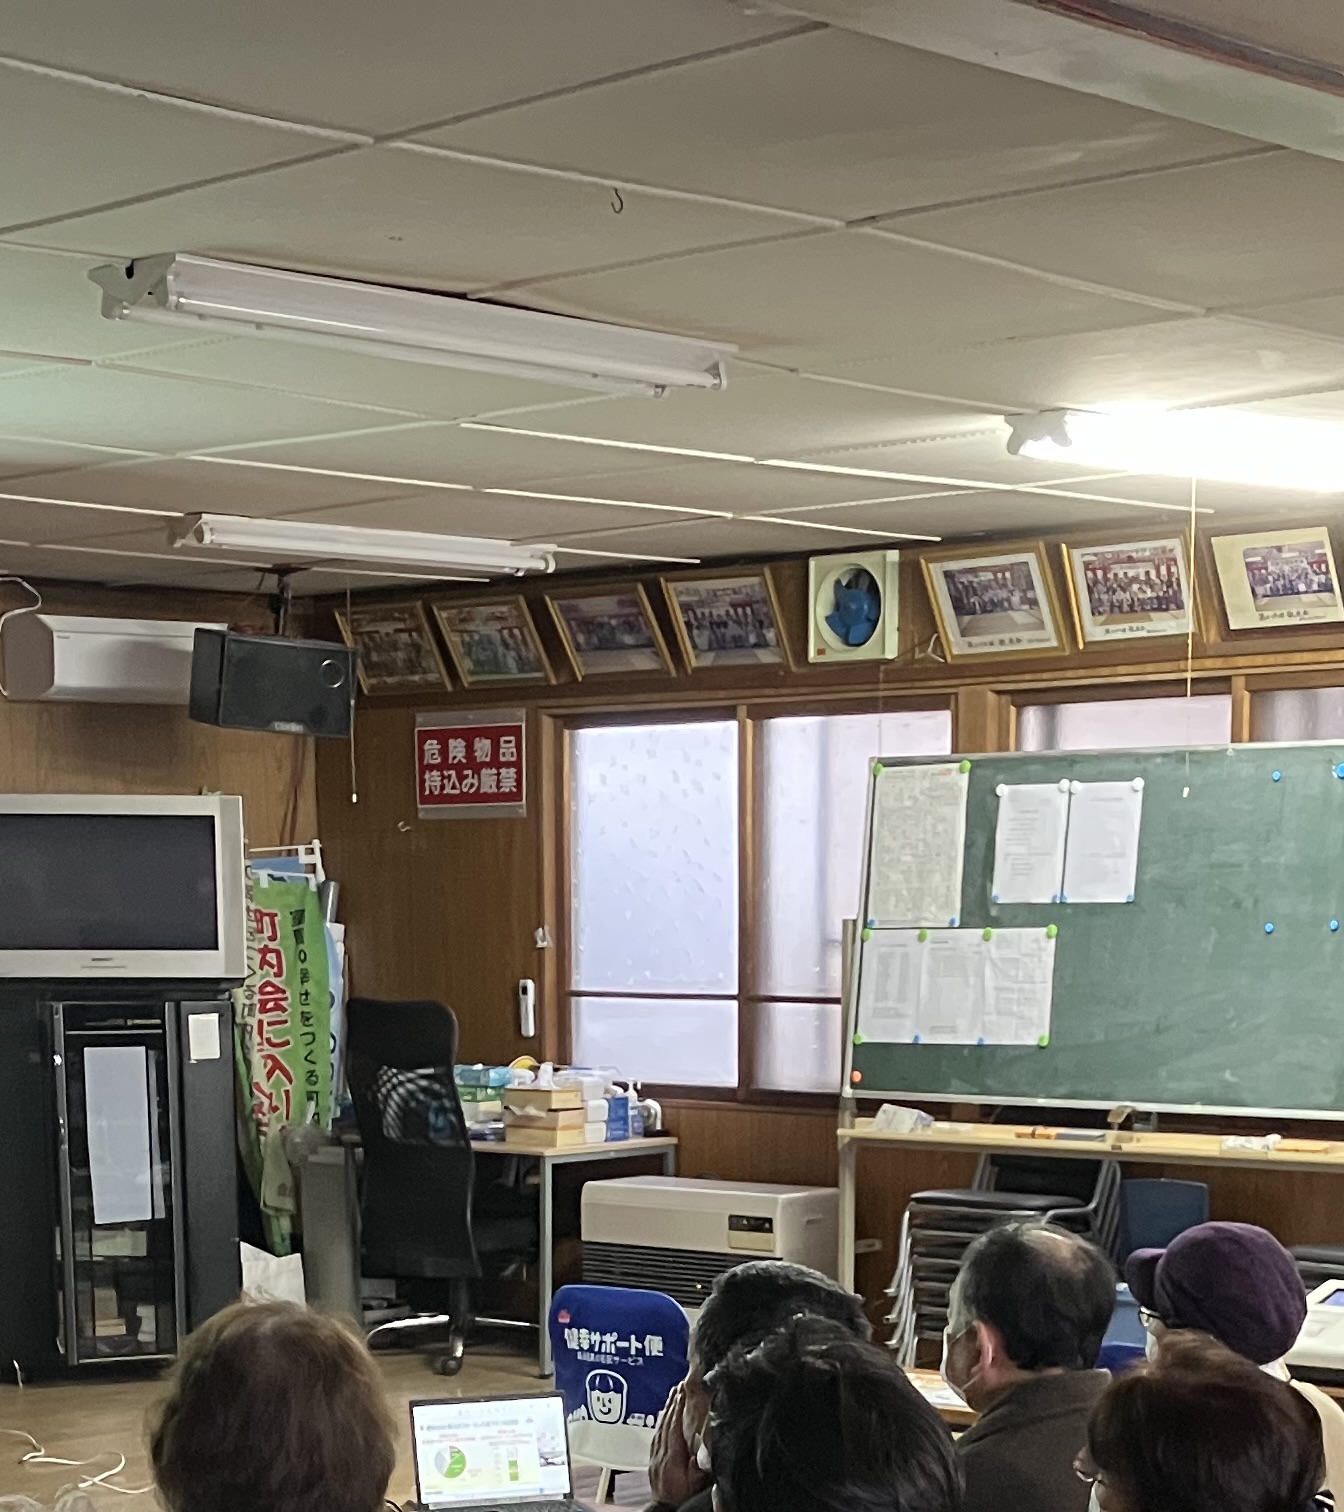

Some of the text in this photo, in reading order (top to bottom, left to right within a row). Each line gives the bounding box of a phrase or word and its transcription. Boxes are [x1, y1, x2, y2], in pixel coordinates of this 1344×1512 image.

[423, 736, 517, 764] 危険物品
[424, 767, 517, 795] 持込み厳禁
[564, 1327, 664, 1357] 健康サポート便
